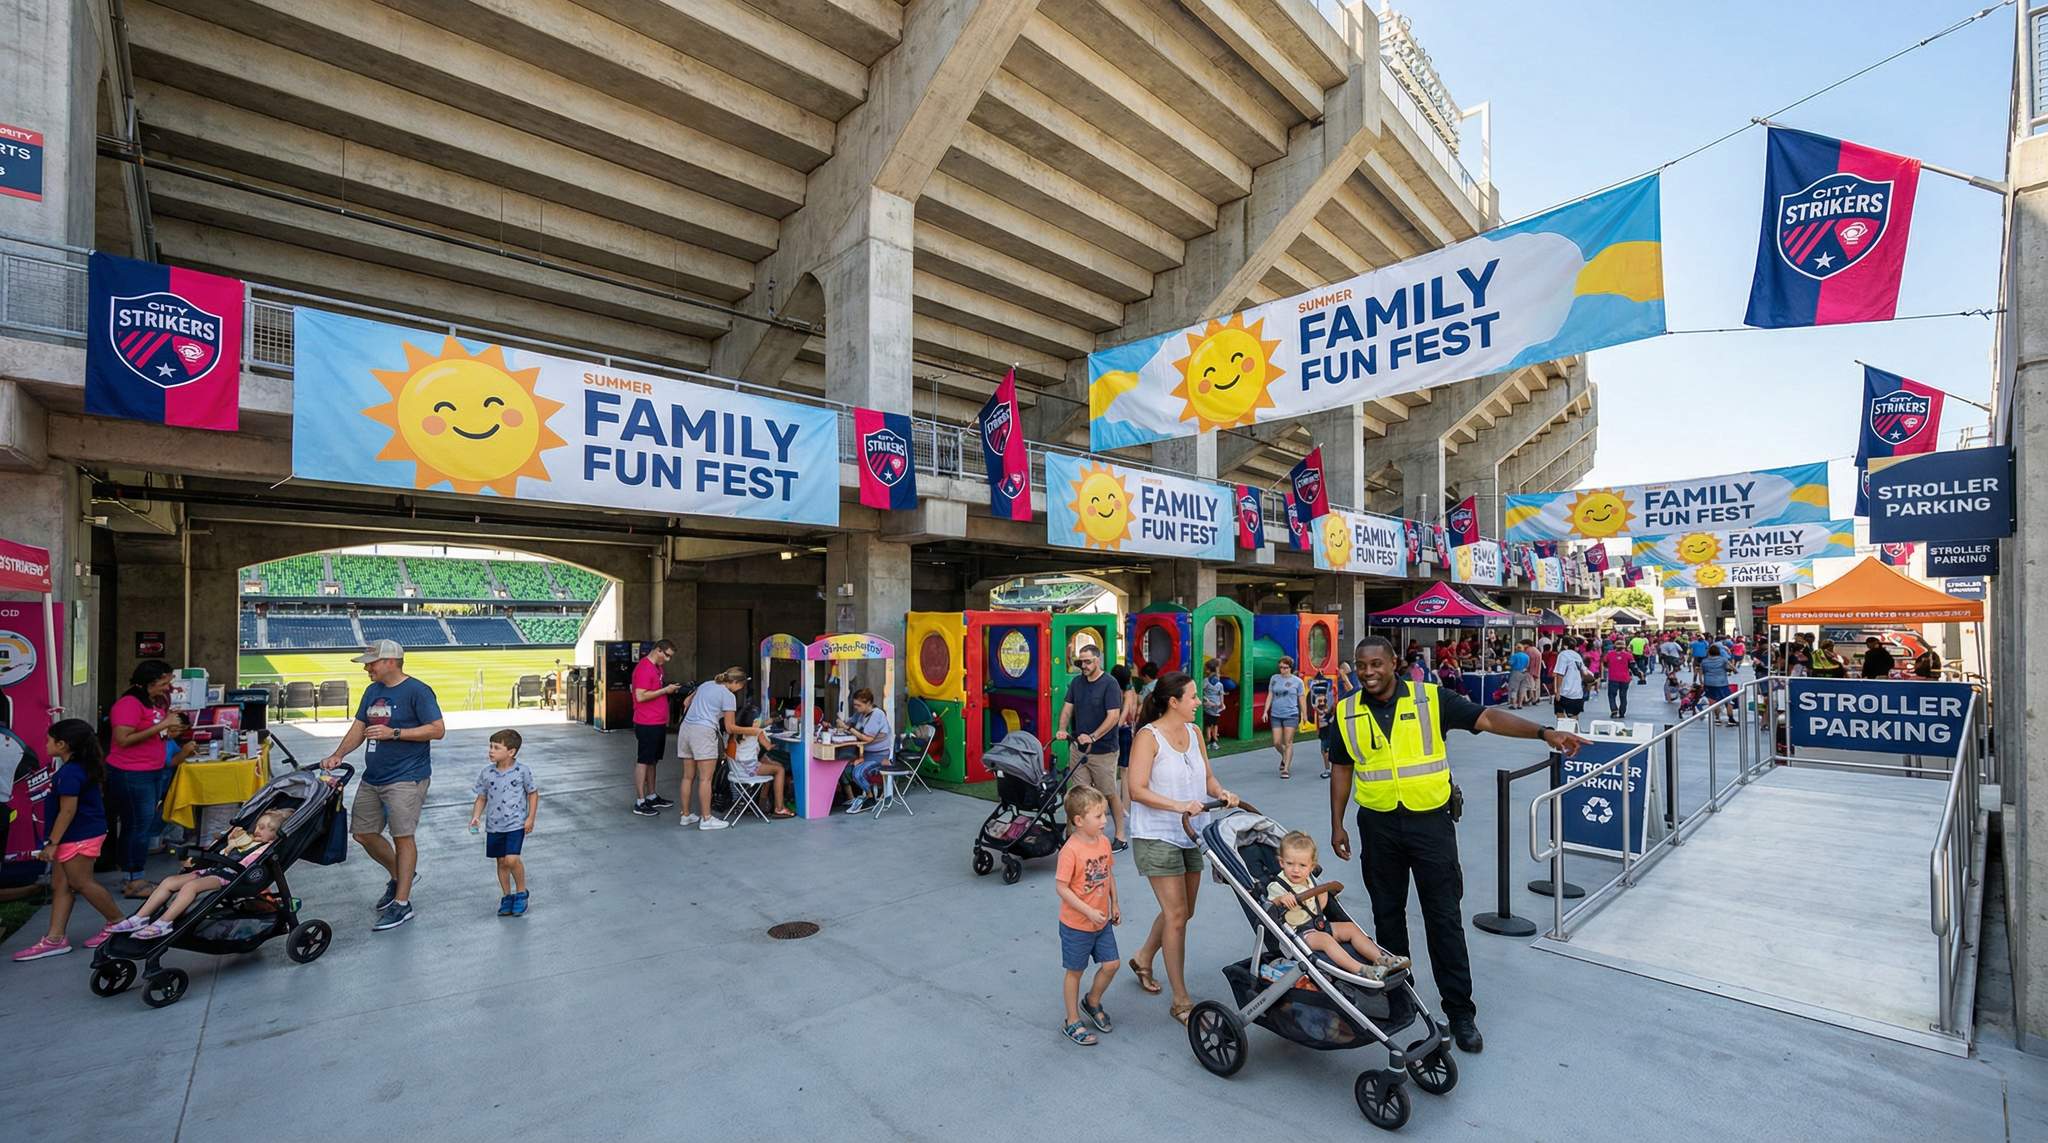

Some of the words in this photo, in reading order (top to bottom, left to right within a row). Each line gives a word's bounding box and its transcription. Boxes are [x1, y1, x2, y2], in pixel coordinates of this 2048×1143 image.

[1812, 183, 1858, 199] CITY
[1785, 193, 1884, 225] STRIKERS
[148, 302, 188, 316] CITY
[1298, 288, 1352, 314] SUMMER
[1299, 258, 1500, 355] FAMILY
[119, 309, 215, 341] STRIKERS
[1301, 344, 1377, 392] FUN
[1390, 311, 1500, 370] FEST
[583, 372, 653, 395] SUMMER
[1874, 402, 1926, 415] STRIKERS
[584, 389, 800, 464] FAMILY
[584, 444, 682, 490] FUN
[696, 459, 799, 501] FEST
[1645, 481, 1756, 511] FAMILY
[1878, 478, 1999, 500] STROLLER
[1141, 485, 1218, 522] FAMILY
[1886, 497, 1991, 518] PARKING
[1645, 510, 1690, 528] FUN
[1697, 504, 1755, 524] FEST
[1142, 518, 1176, 542] FUN
[1180, 522, 1218, 546] FEST
[1355, 524, 1396, 549] FAMILY
[1729, 530, 1804, 547] FAMILY
[1356, 547, 1375, 564] FUN
[1376, 550, 1398, 566] FEST
[1729, 547, 1760, 559] FUN
[1764, 545, 1804, 557] FEST
[1930, 545, 1991, 556] STROLLER
[1934, 554, 1987, 565] PARKING
[1731, 565, 1781, 576] FAMILY
[1731, 575, 1753, 583] FUN
[1755, 574, 1781, 582] FEST
[1799, 692, 1962, 718] STROLLER
[1809, 717, 1951, 743] PARKING
[1566, 775, 1635, 793] PRKING
